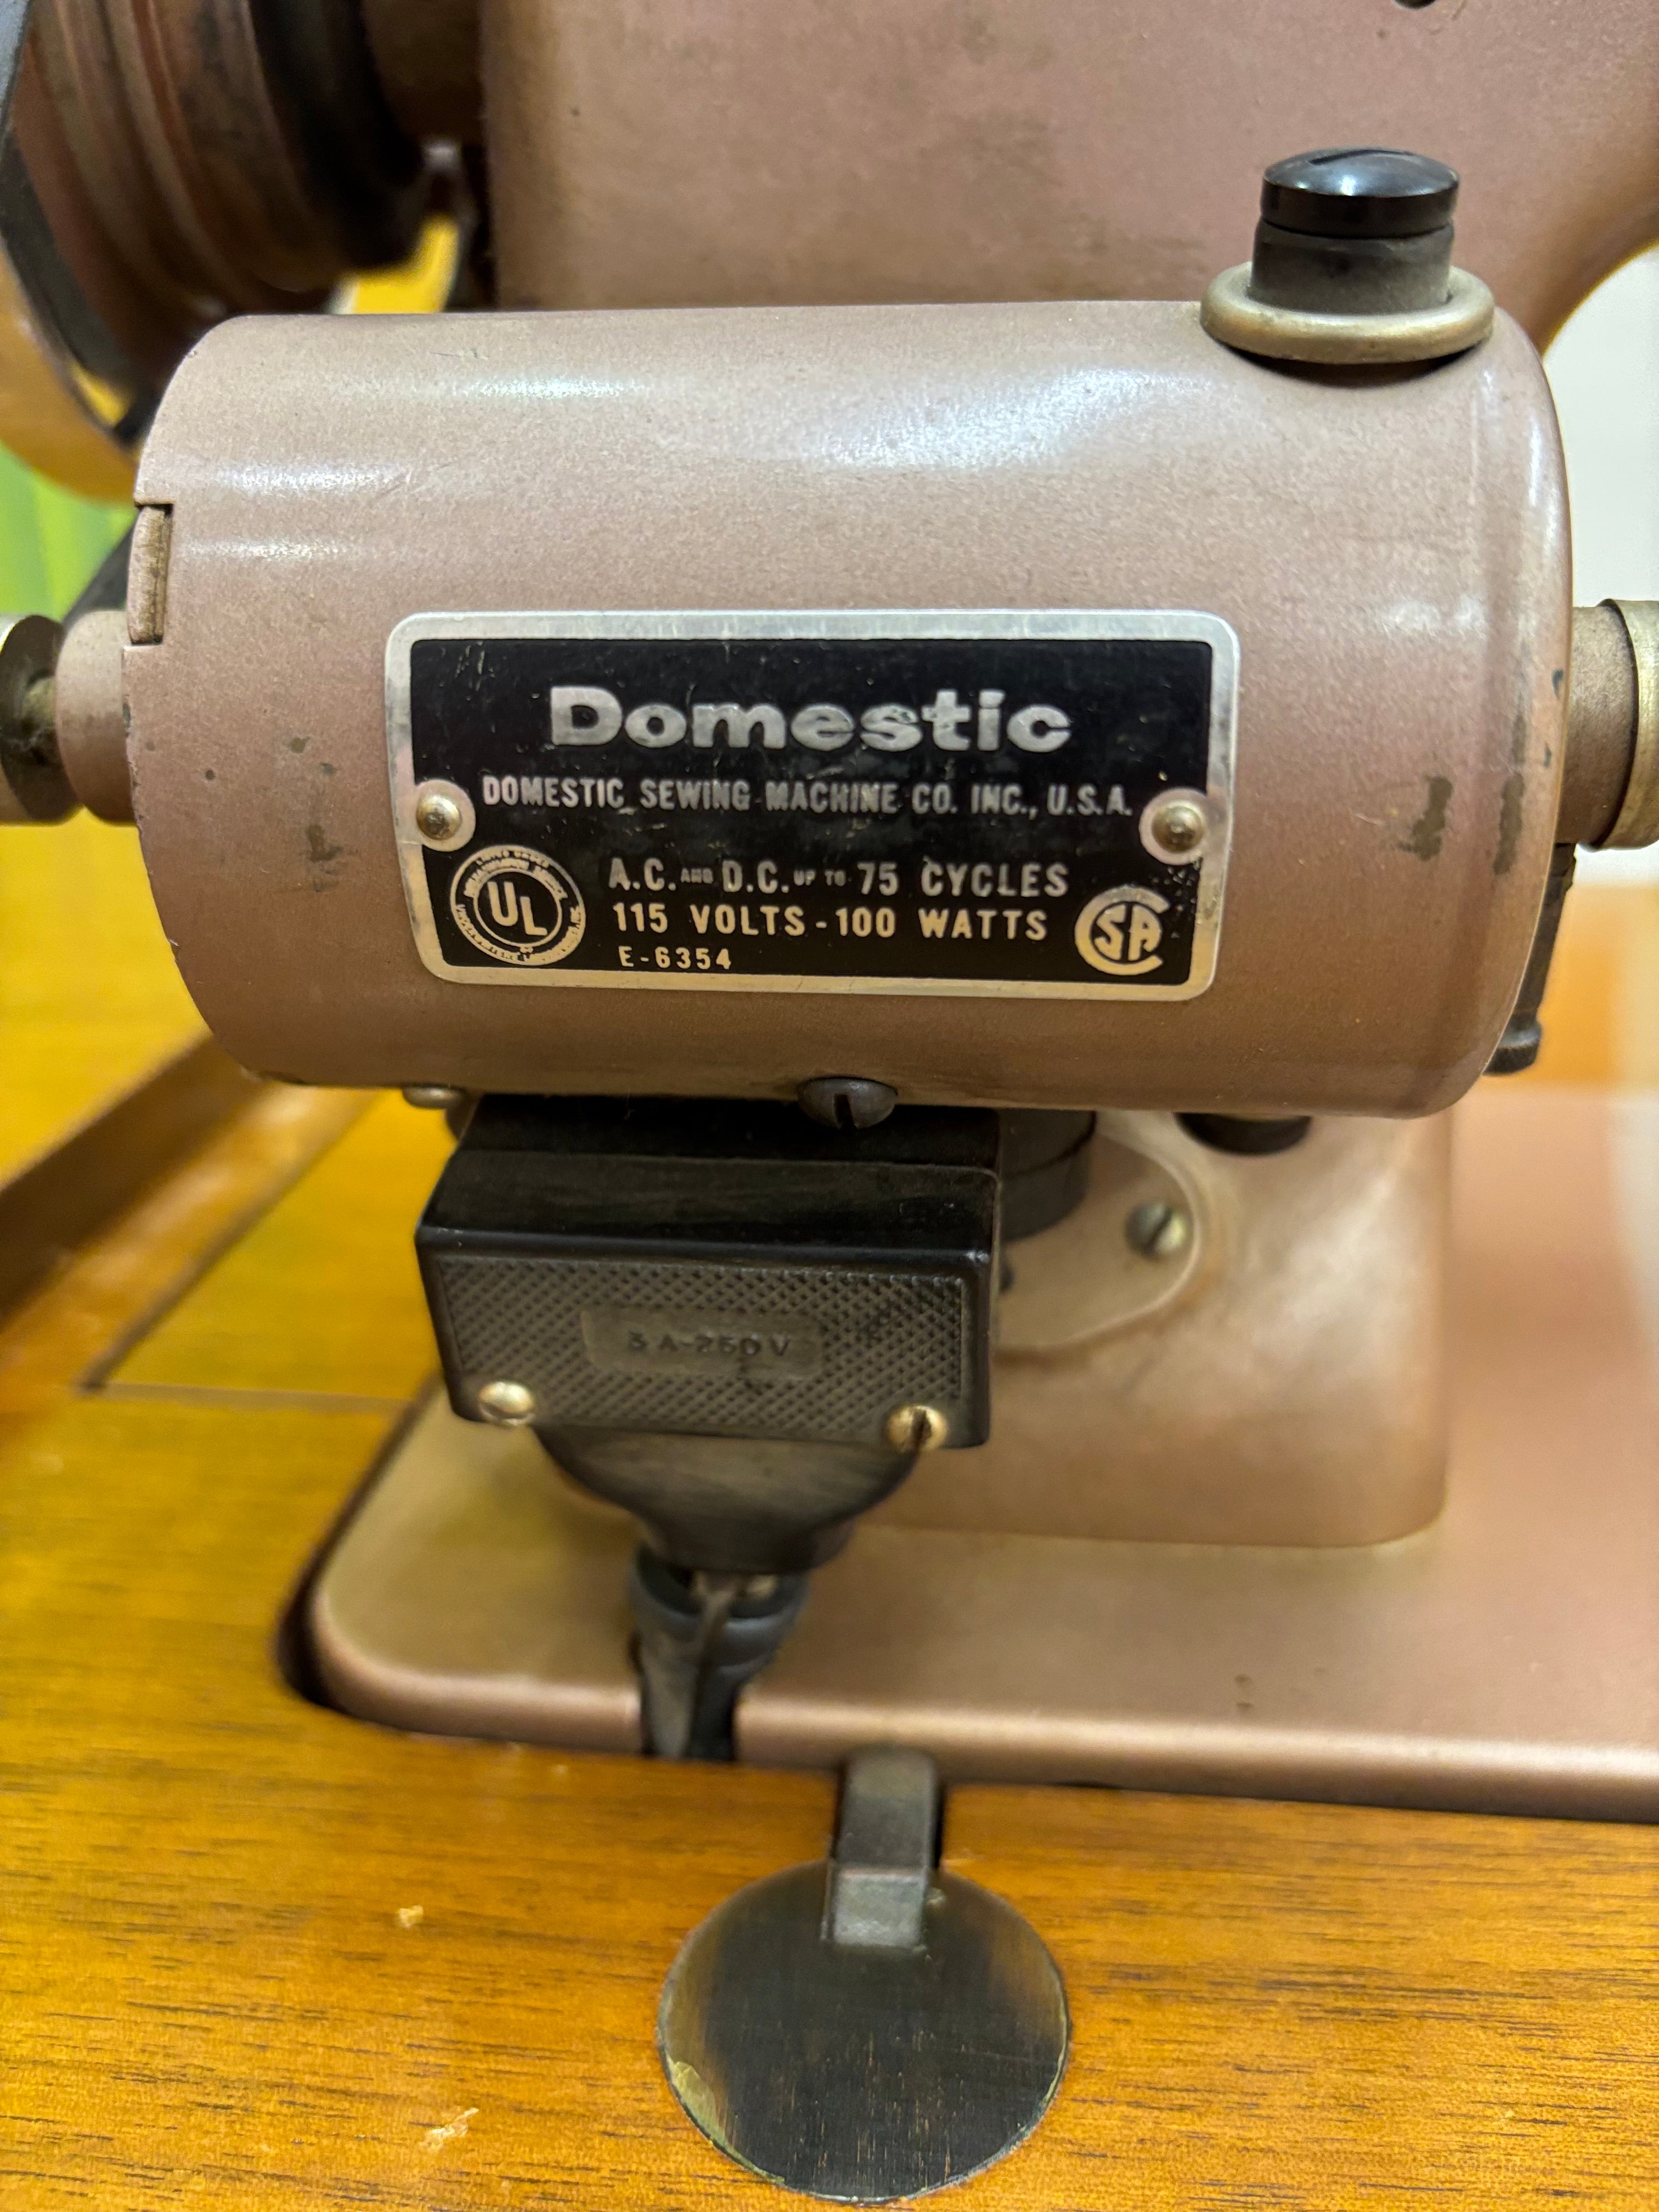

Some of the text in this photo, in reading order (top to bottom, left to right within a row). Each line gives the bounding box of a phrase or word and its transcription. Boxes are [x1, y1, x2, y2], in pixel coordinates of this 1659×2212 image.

[551, 686, 1071, 752] Domestic
[482, 775, 624, 807] DOMESTIC
[640, 779, 751, 811] SEWING
[765, 781, 898, 814] MACHINE
[912, 783, 957, 815] CO.
[1046, 785, 1132, 816] U.S.A.
[608, 857, 676, 891] A.C.
[721, 860, 789, 894] D.C.
[793, 870, 816, 886] UP
[825, 870, 846, 886] TO
[857, 861, 899, 896] 75
[921, 862, 1069, 898] CYCLES
[613, 902, 668, 933] 115
[918, 908, 1047, 941] WATTS
